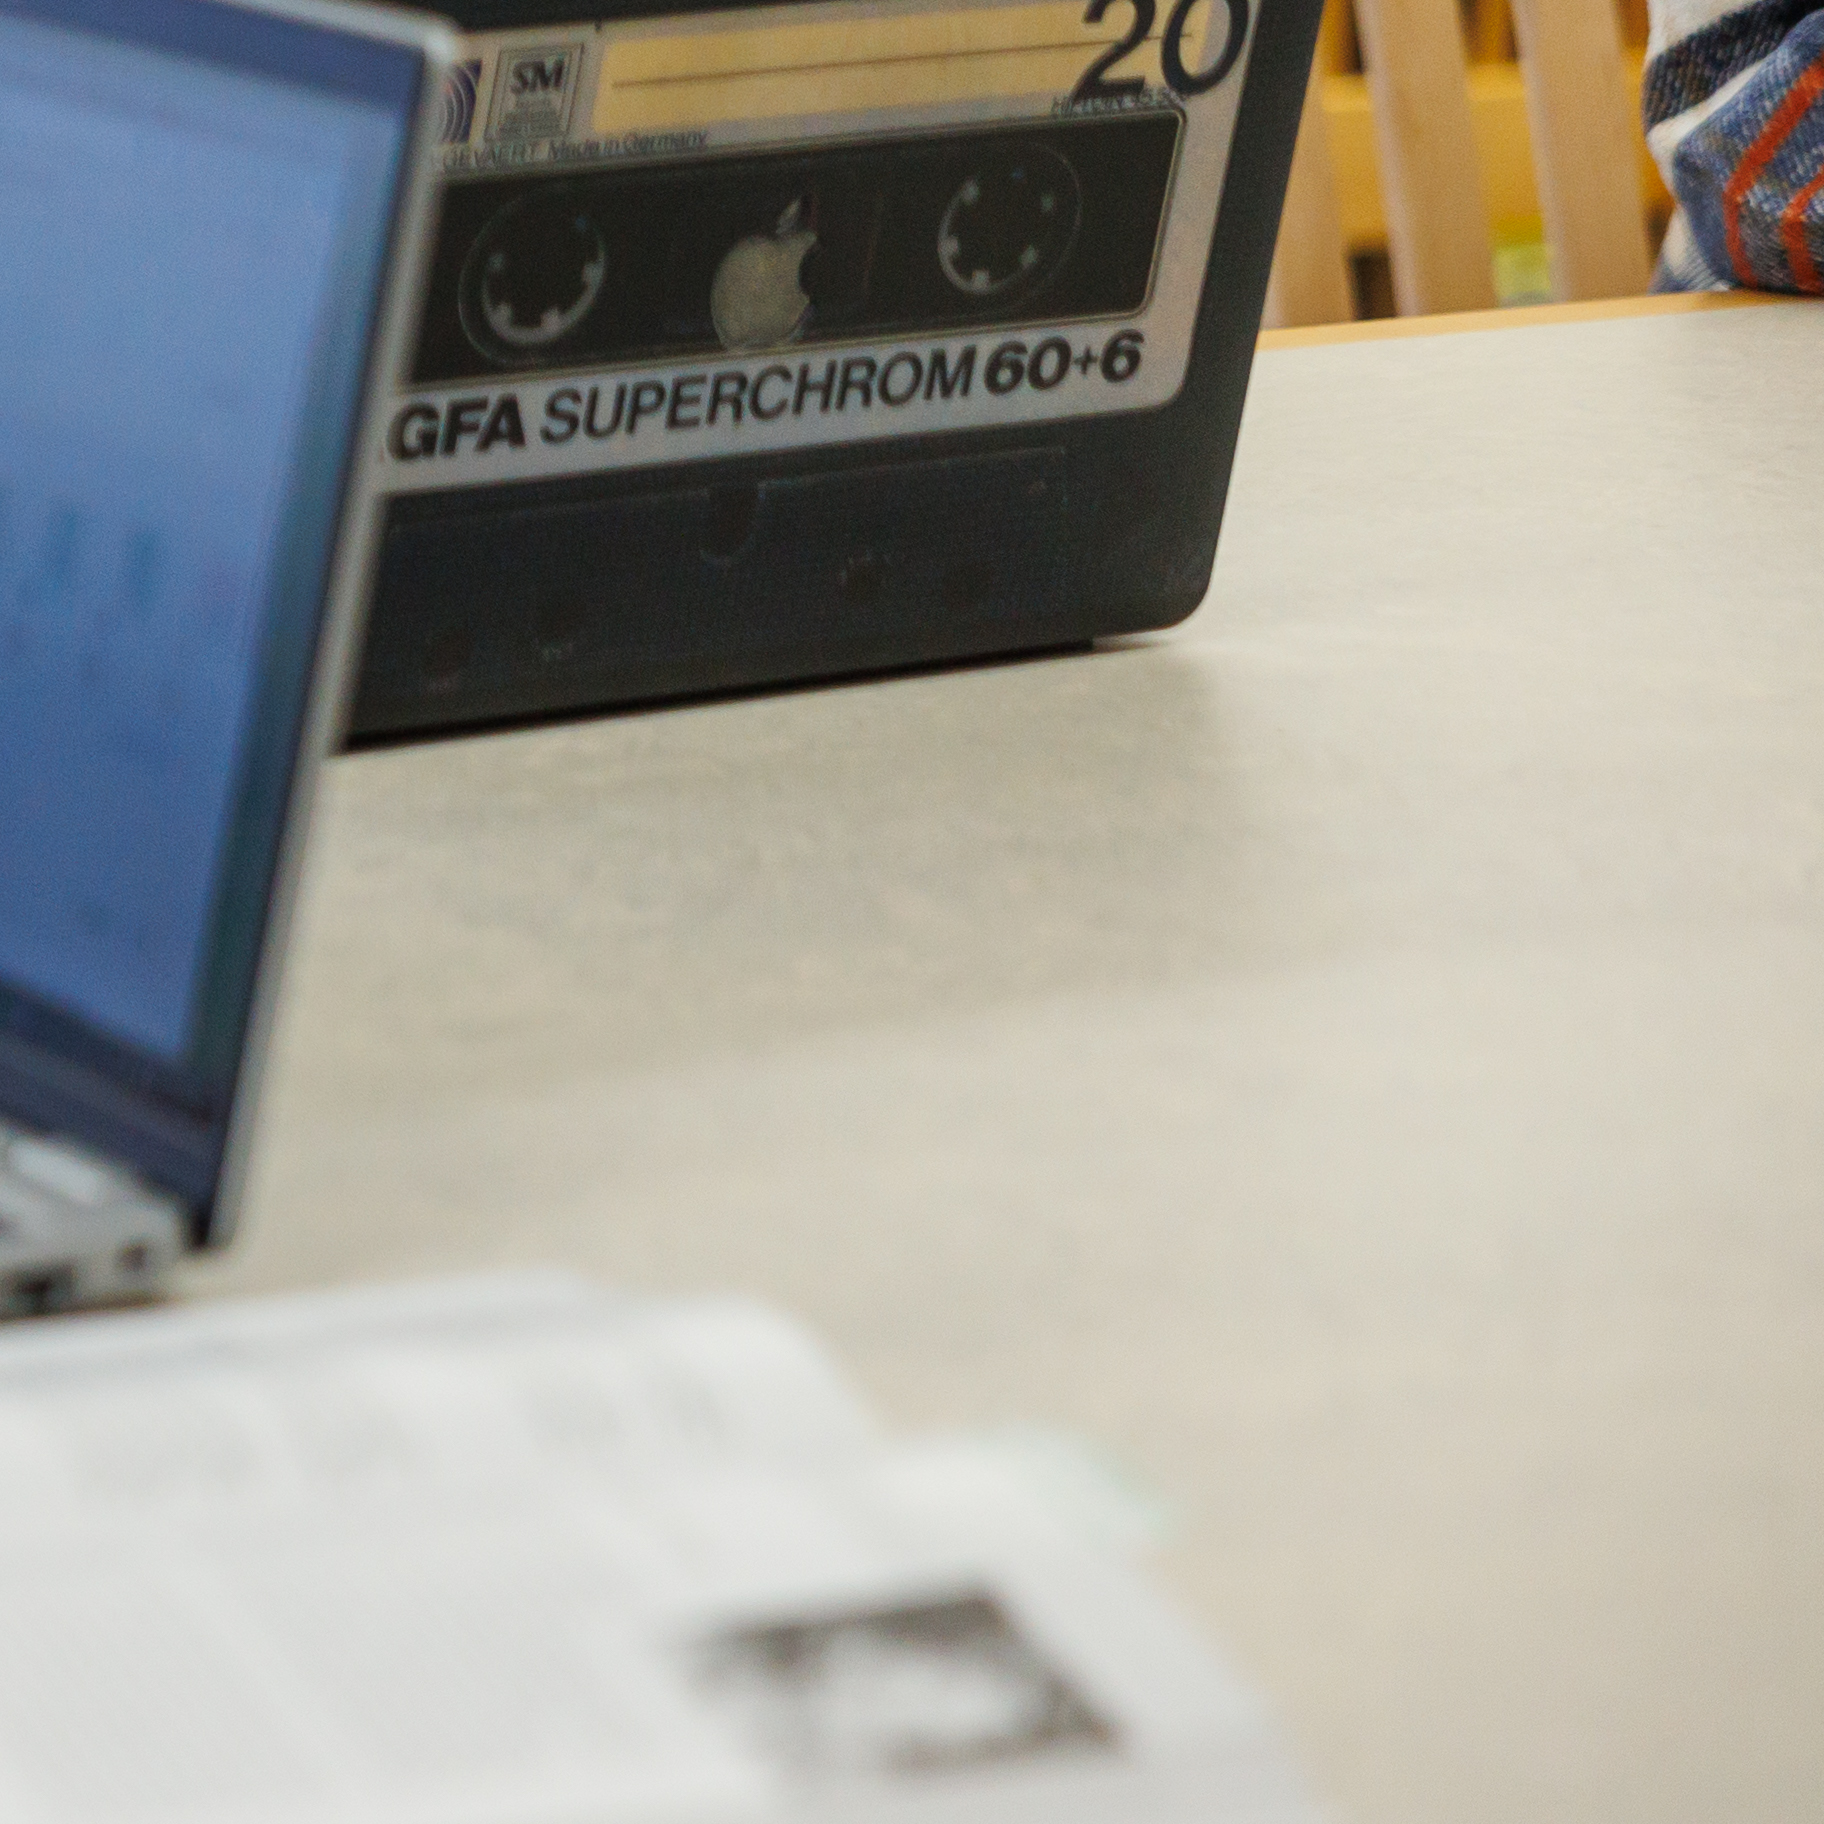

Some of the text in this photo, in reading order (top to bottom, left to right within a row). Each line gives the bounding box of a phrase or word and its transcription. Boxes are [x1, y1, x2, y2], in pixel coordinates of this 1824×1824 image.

[510, 54, 565, 95] SM
[378, 328, 1145, 463] GFA SUPERCHROM 60+6
